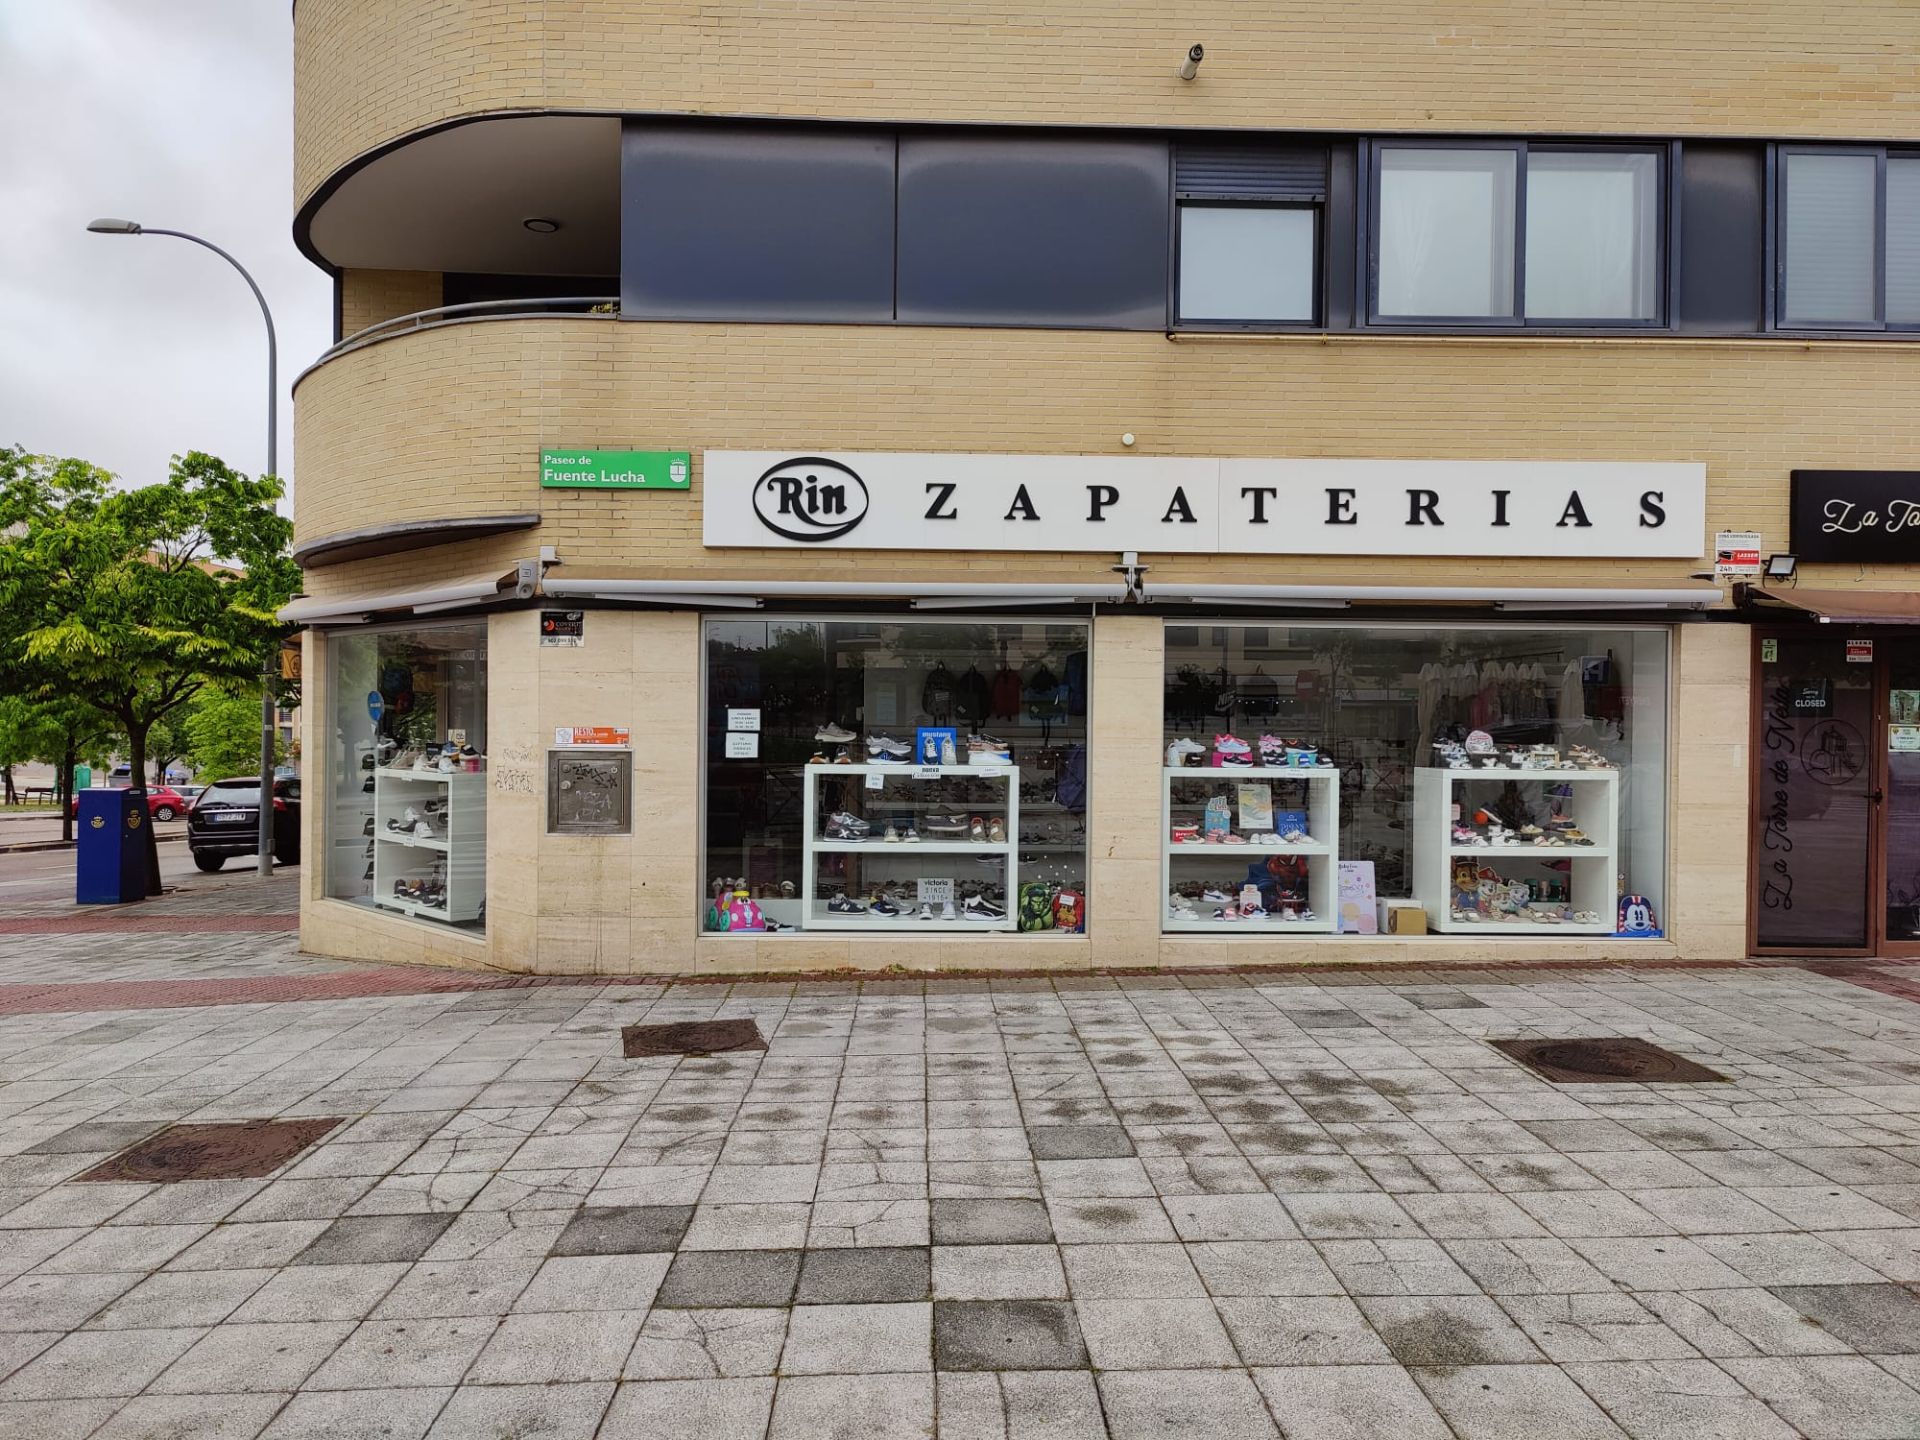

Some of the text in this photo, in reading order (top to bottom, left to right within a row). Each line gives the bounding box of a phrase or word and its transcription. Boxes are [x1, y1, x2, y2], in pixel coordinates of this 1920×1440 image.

[544, 455, 592, 465] Paseo de
[544, 469, 646, 483] Fuente Lucha
[767, 475, 849, 526] Rin
[924, 482, 1667, 529] ZAPATERIAS
[1822, 499, 1880, 533] La
[1795, 699, 1826, 708] CLOSED
[922, 731, 952, 739] mustang
[1768, 759, 1789, 785] de
[1764, 789, 1793, 853] Torre
[1763, 859, 1793, 911] La
